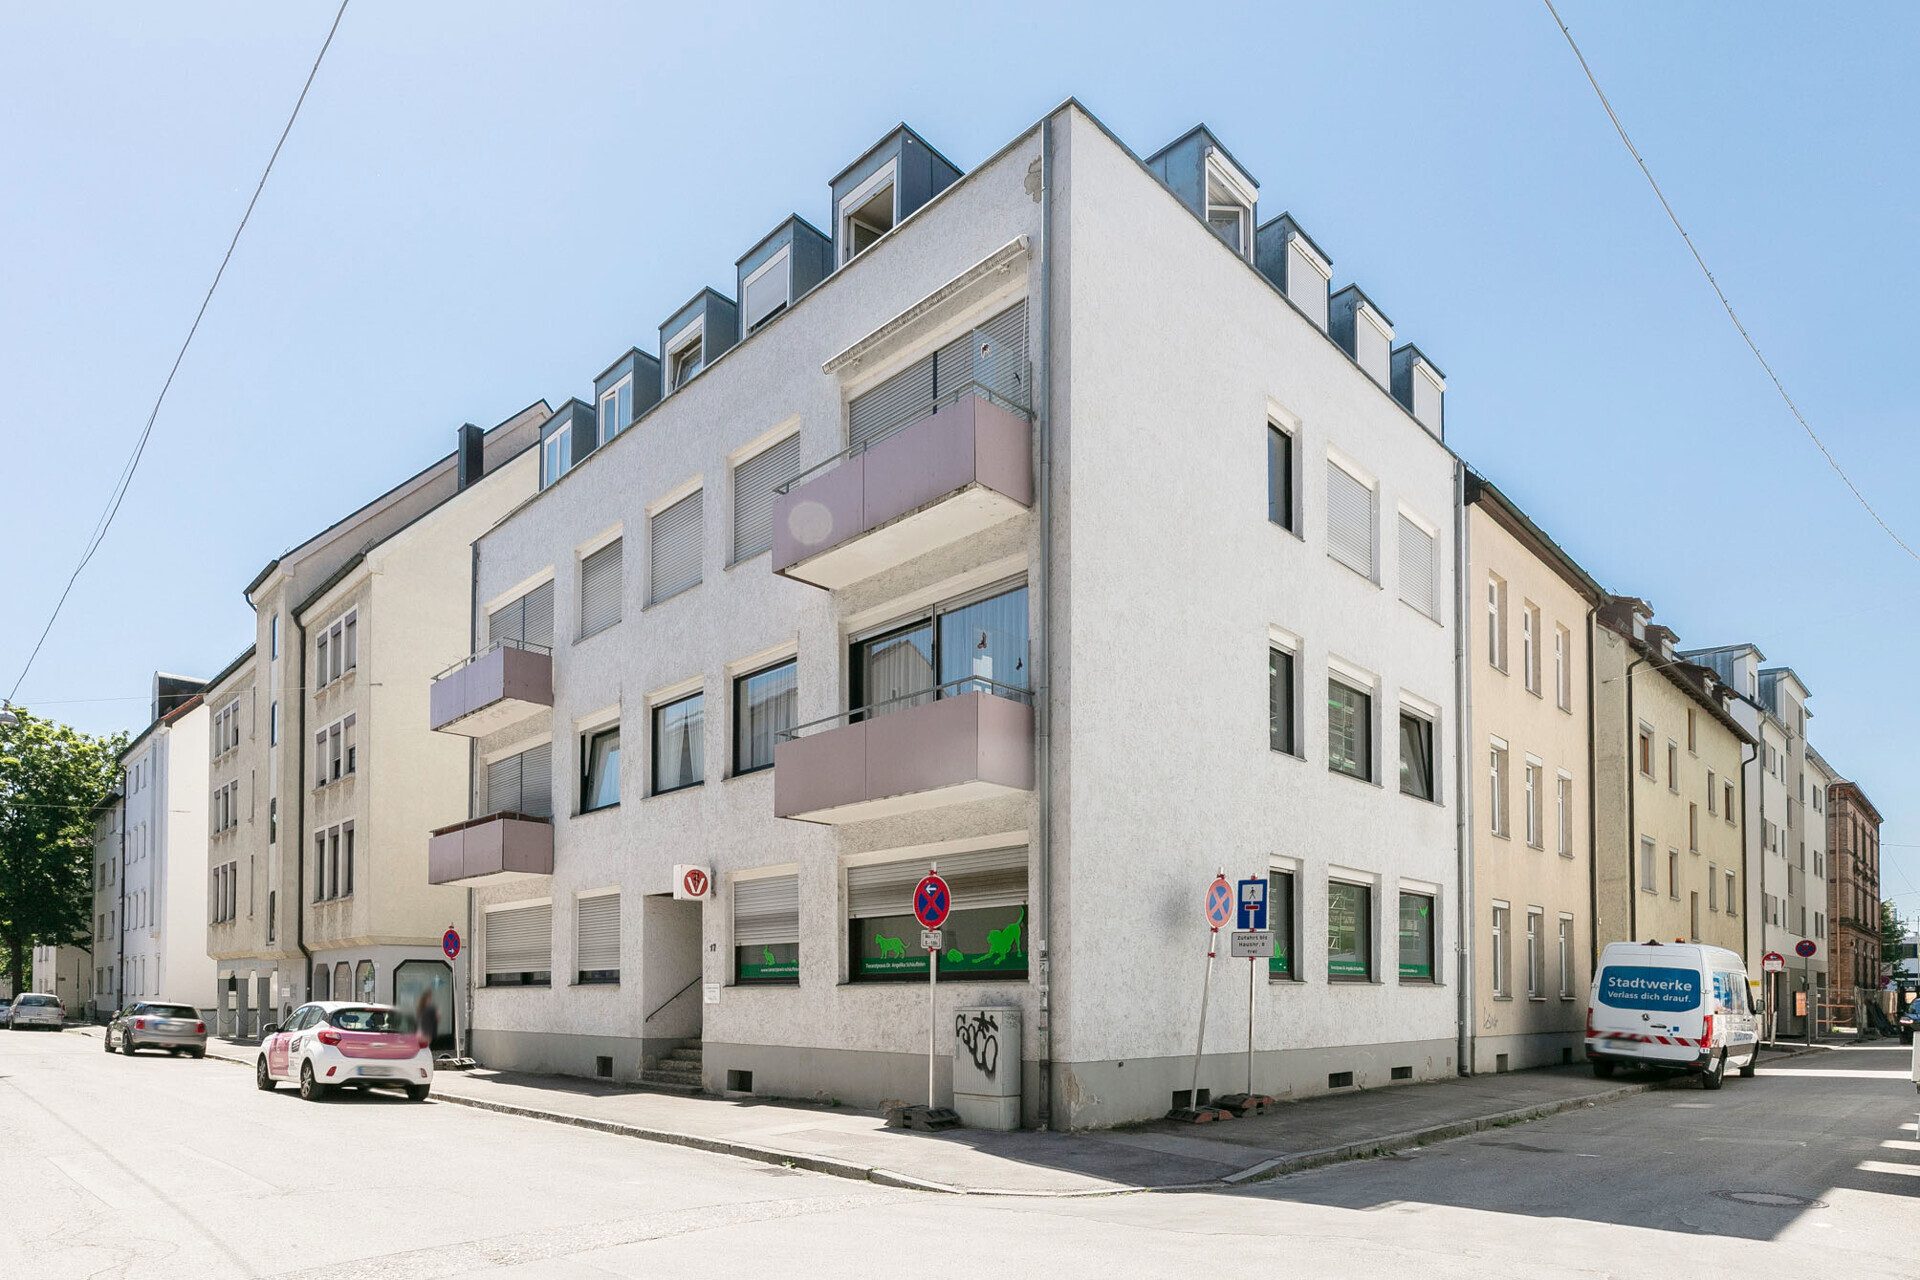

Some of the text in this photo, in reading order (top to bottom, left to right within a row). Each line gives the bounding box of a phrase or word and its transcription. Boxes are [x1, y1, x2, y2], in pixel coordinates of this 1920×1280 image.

[1608, 977, 1693, 992] Stadtwerke
[1607, 990, 1692, 1003] Verlass dich drauf.
